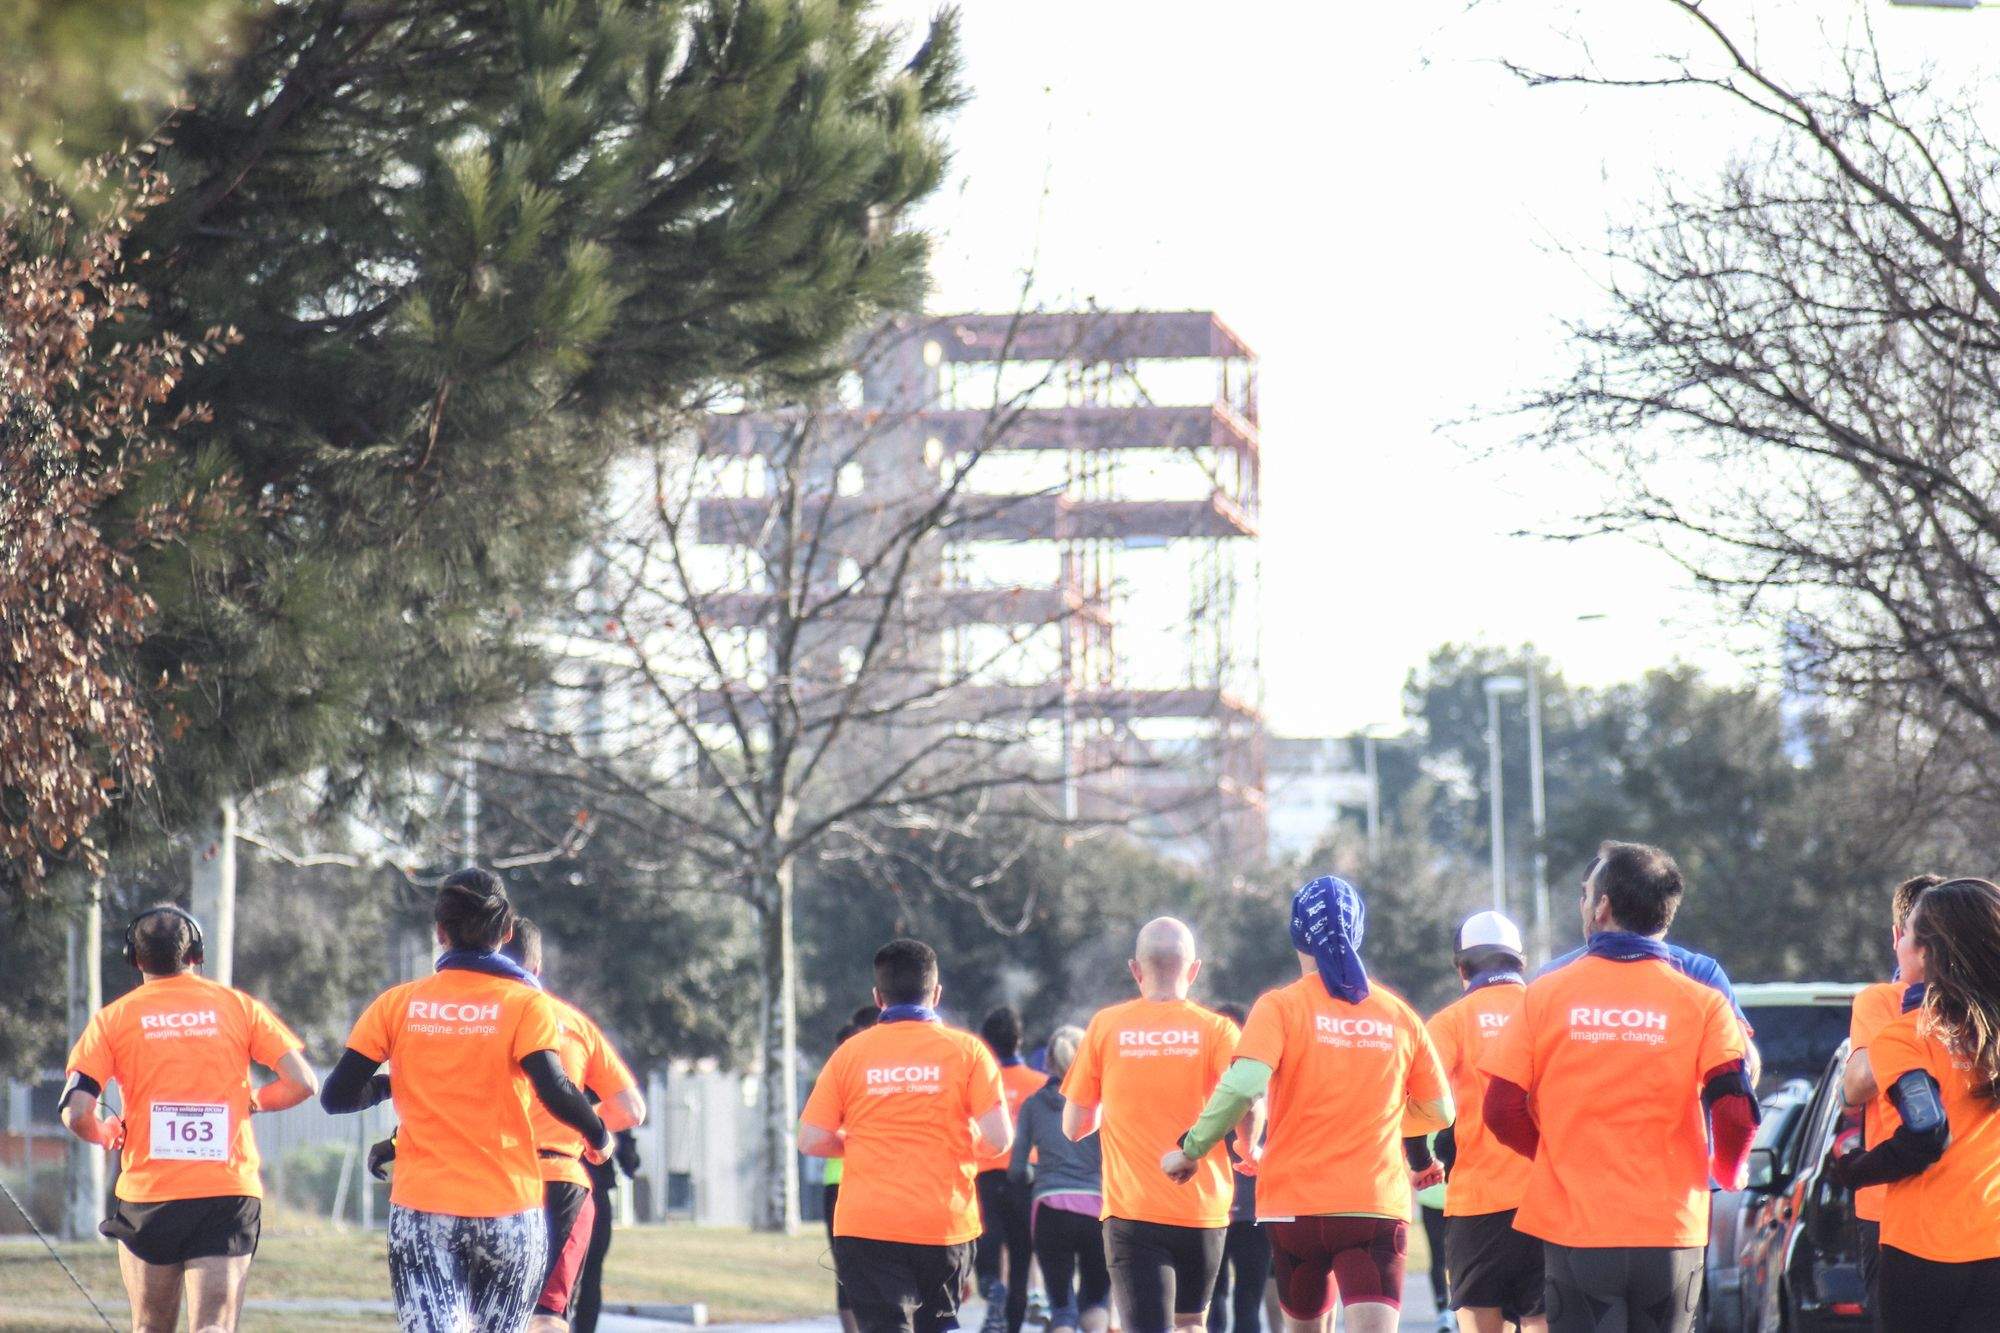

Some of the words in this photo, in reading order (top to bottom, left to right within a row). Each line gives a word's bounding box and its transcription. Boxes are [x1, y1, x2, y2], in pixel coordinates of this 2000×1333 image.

[140, 1010, 217, 1029] RICOH
[408, 1001, 499, 1022] RICOH
[1570, 1007, 1668, 1030] RICOH
[1316, 1015, 1393, 1039] RICOH
[1119, 1030, 1200, 1046] RICOH
[866, 1066, 941, 1085] RICOH
[166, 1120, 214, 1142] 163
